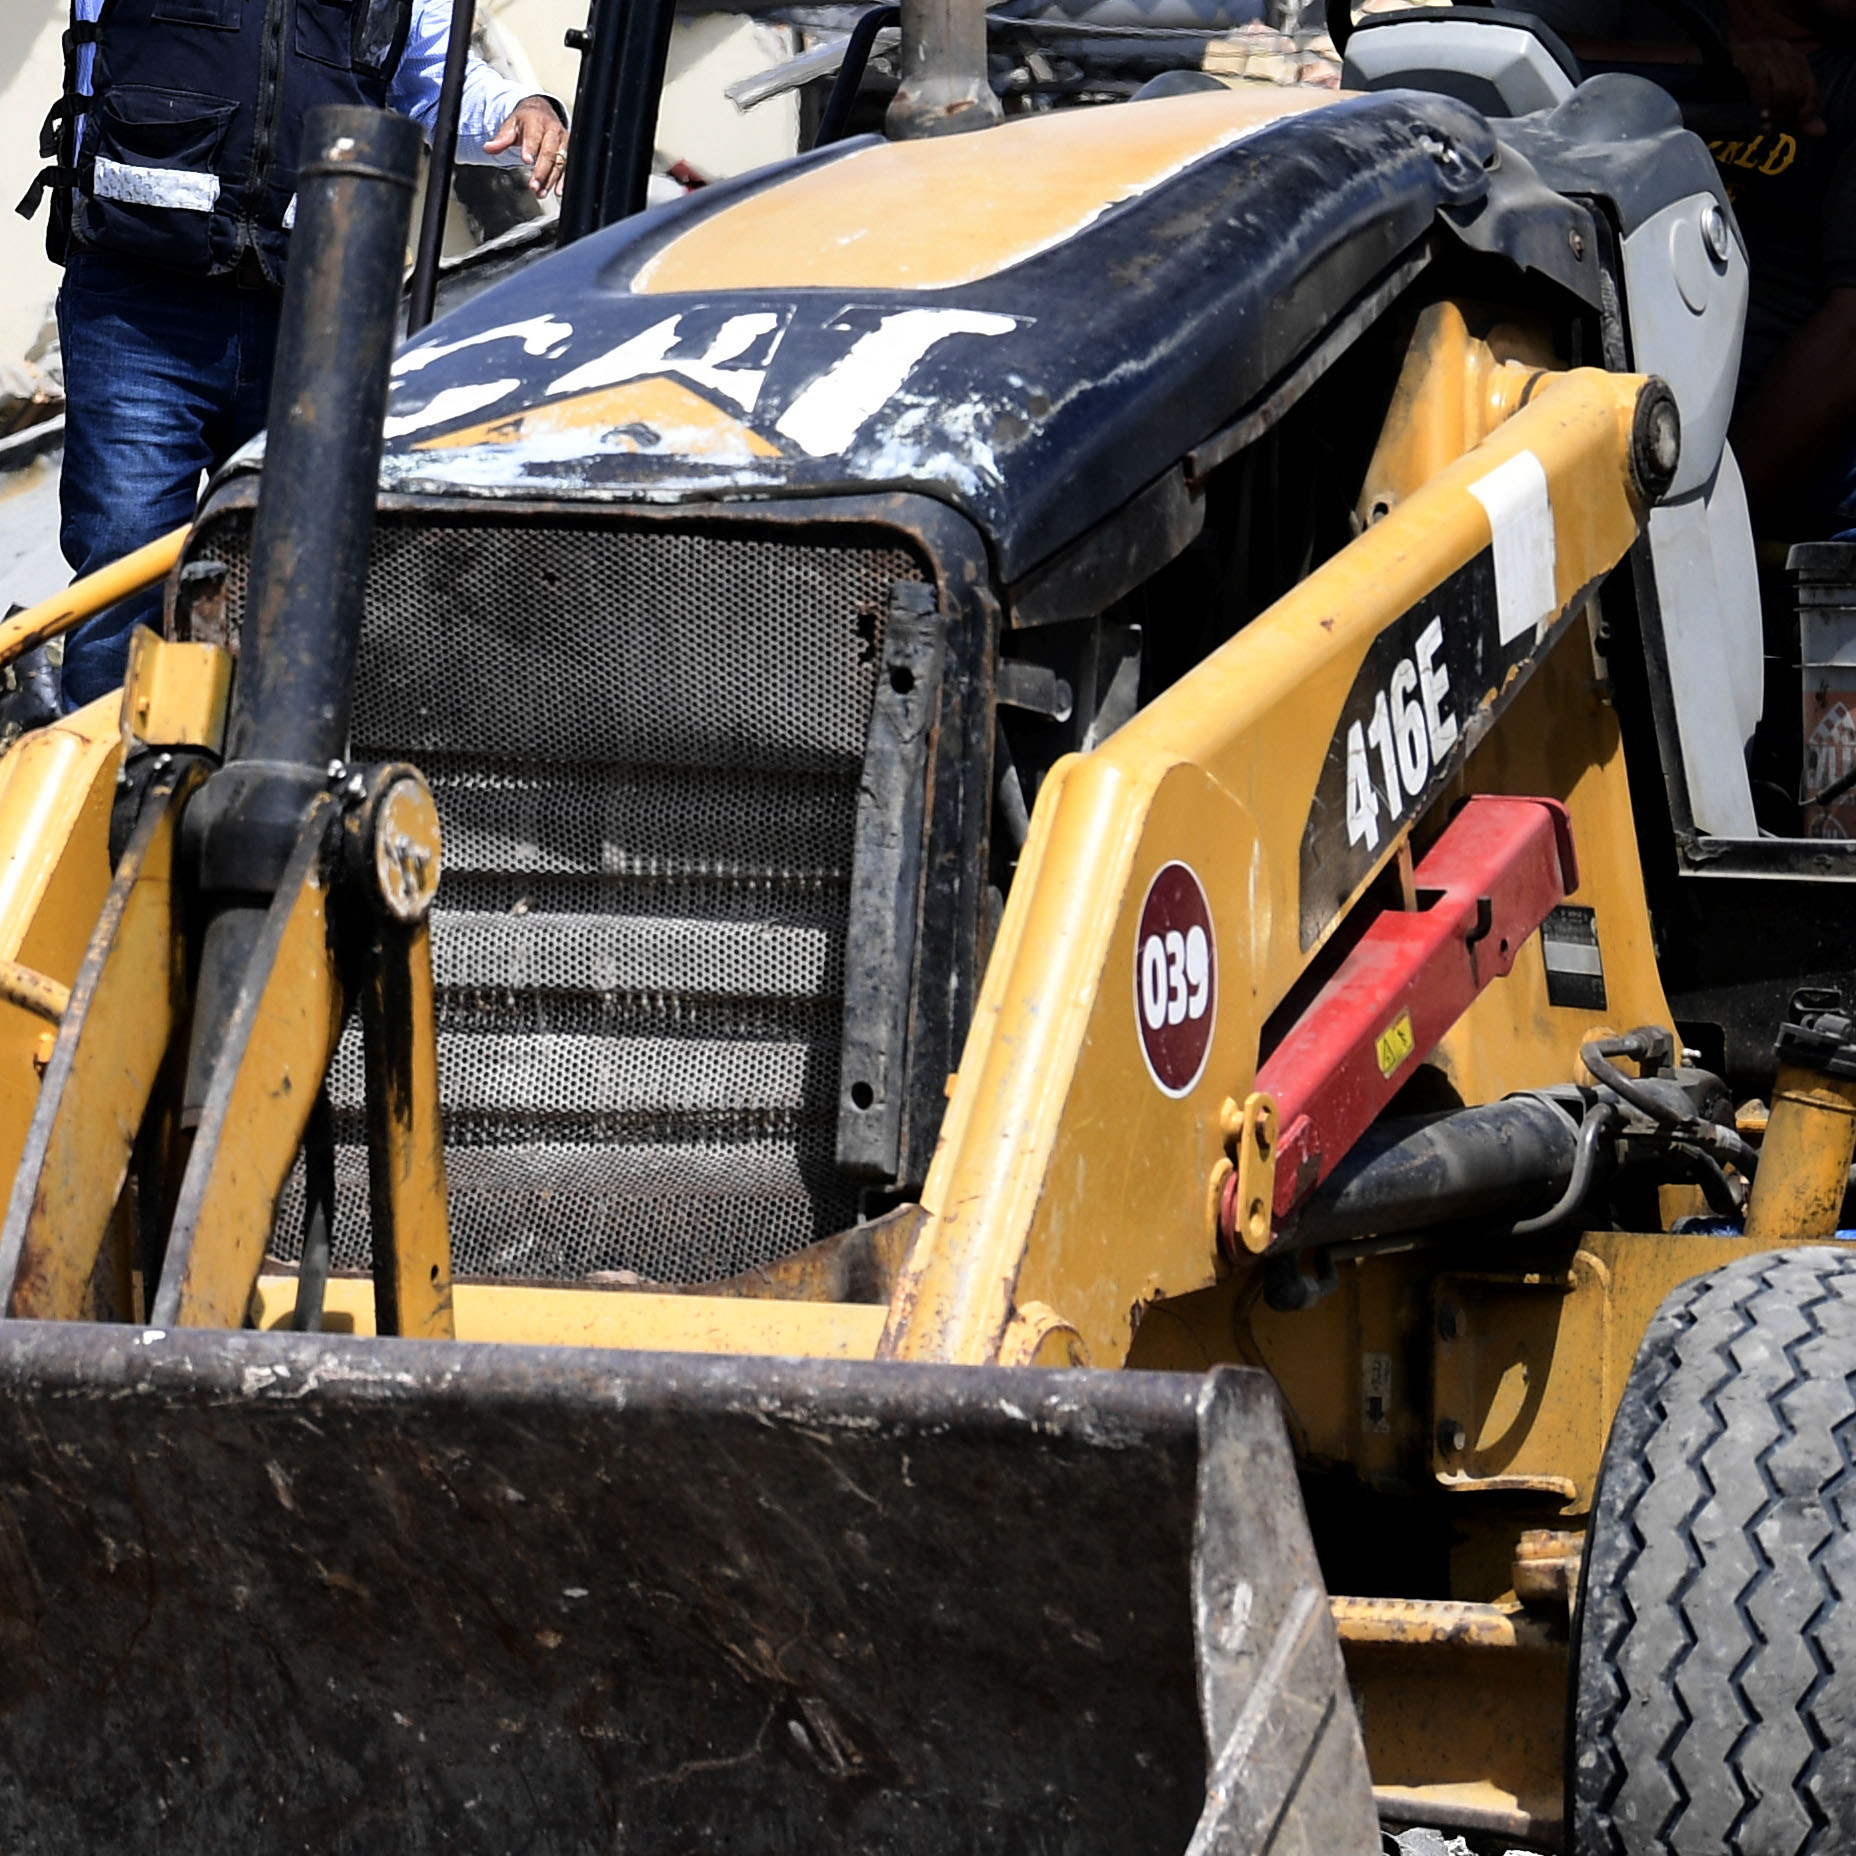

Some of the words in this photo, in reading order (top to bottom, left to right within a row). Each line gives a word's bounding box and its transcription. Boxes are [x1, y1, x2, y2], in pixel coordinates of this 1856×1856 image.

[1707, 133, 1797, 176] LD
[383, 305, 1023, 458] CAT
[1345, 614, 1458, 852] 416E
[1142, 924, 1210, 1031] 039
